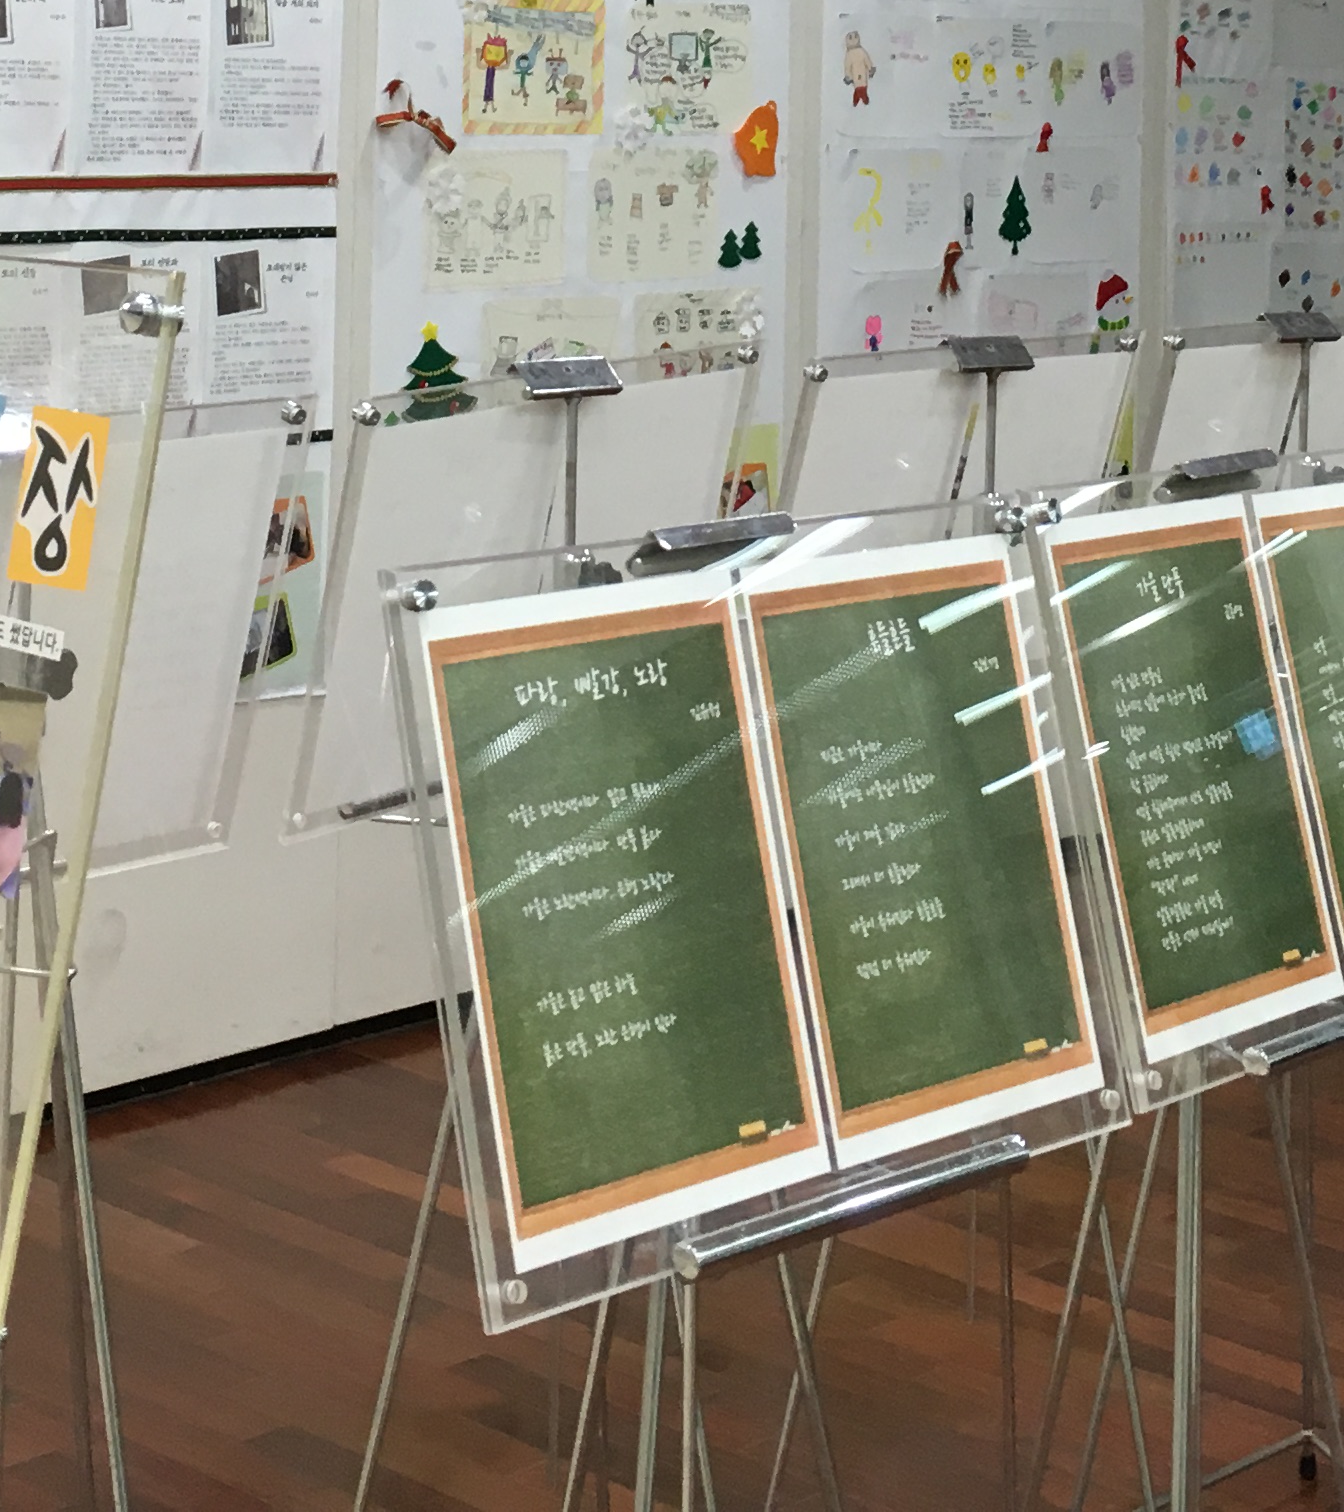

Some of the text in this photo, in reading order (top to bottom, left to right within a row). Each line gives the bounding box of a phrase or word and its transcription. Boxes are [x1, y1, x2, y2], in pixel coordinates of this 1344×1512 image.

[1136, 565, 1185, 603] 가을 단풍
[9, 622, 61, 654] 썼답니다.
[514, 657, 669, 708] 파랑, 빨강, 노랑
[508, 802, 537, 829] 가을은
[522, 895, 552, 921] 가을은
[536, 990, 566, 1017] 가을은
